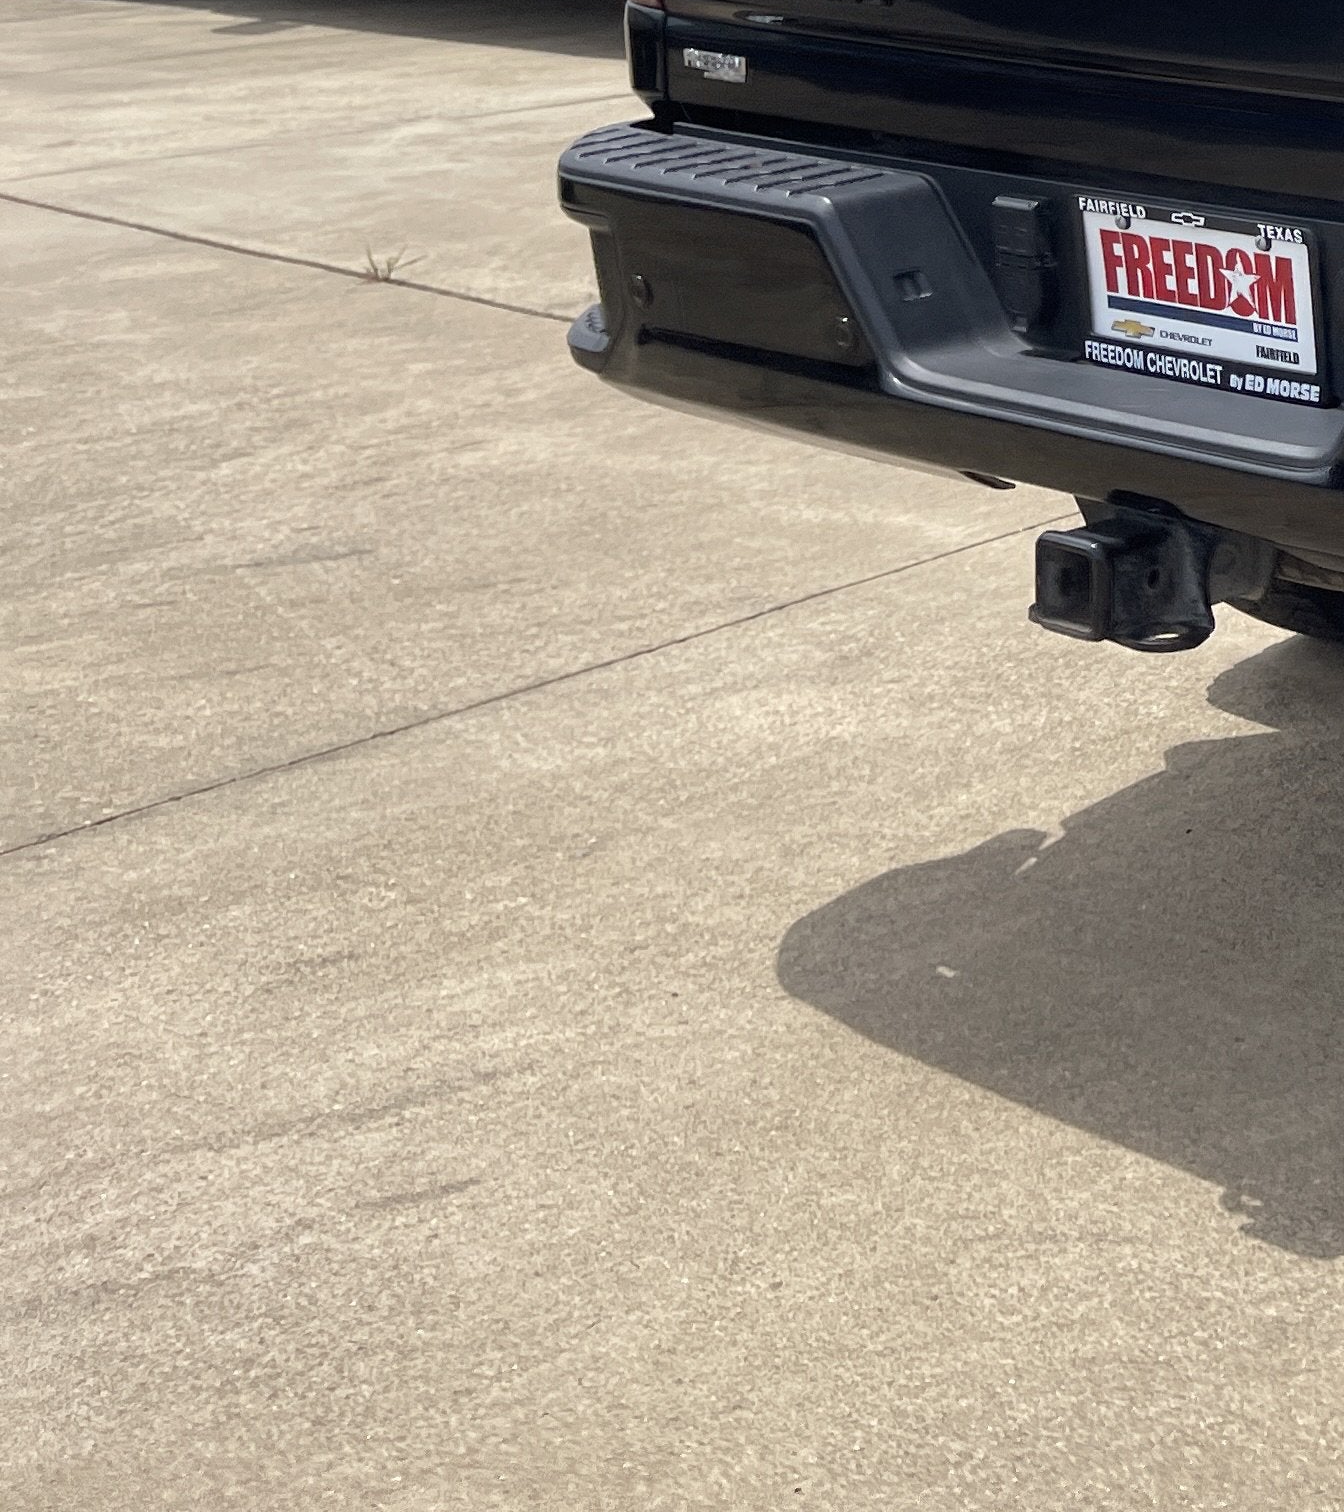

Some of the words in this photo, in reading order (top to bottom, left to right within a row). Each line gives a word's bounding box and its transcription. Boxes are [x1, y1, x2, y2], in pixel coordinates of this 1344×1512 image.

[1078, 197, 1147, 220] FAIRFIELD
[1256, 223, 1304, 245] TEXAS
[1099, 228, 1297, 325] FREEDOM
[1159, 329, 1213, 347] CHEVROLET
[1256, 344, 1300, 365] FAIRFIELD
[1085, 340, 1145, 371] FREEDOM
[1146, 352, 1224, 385] CHEVROLET
[1244, 373, 1266, 393] ED
[1266, 377, 1321, 403] MORSE
